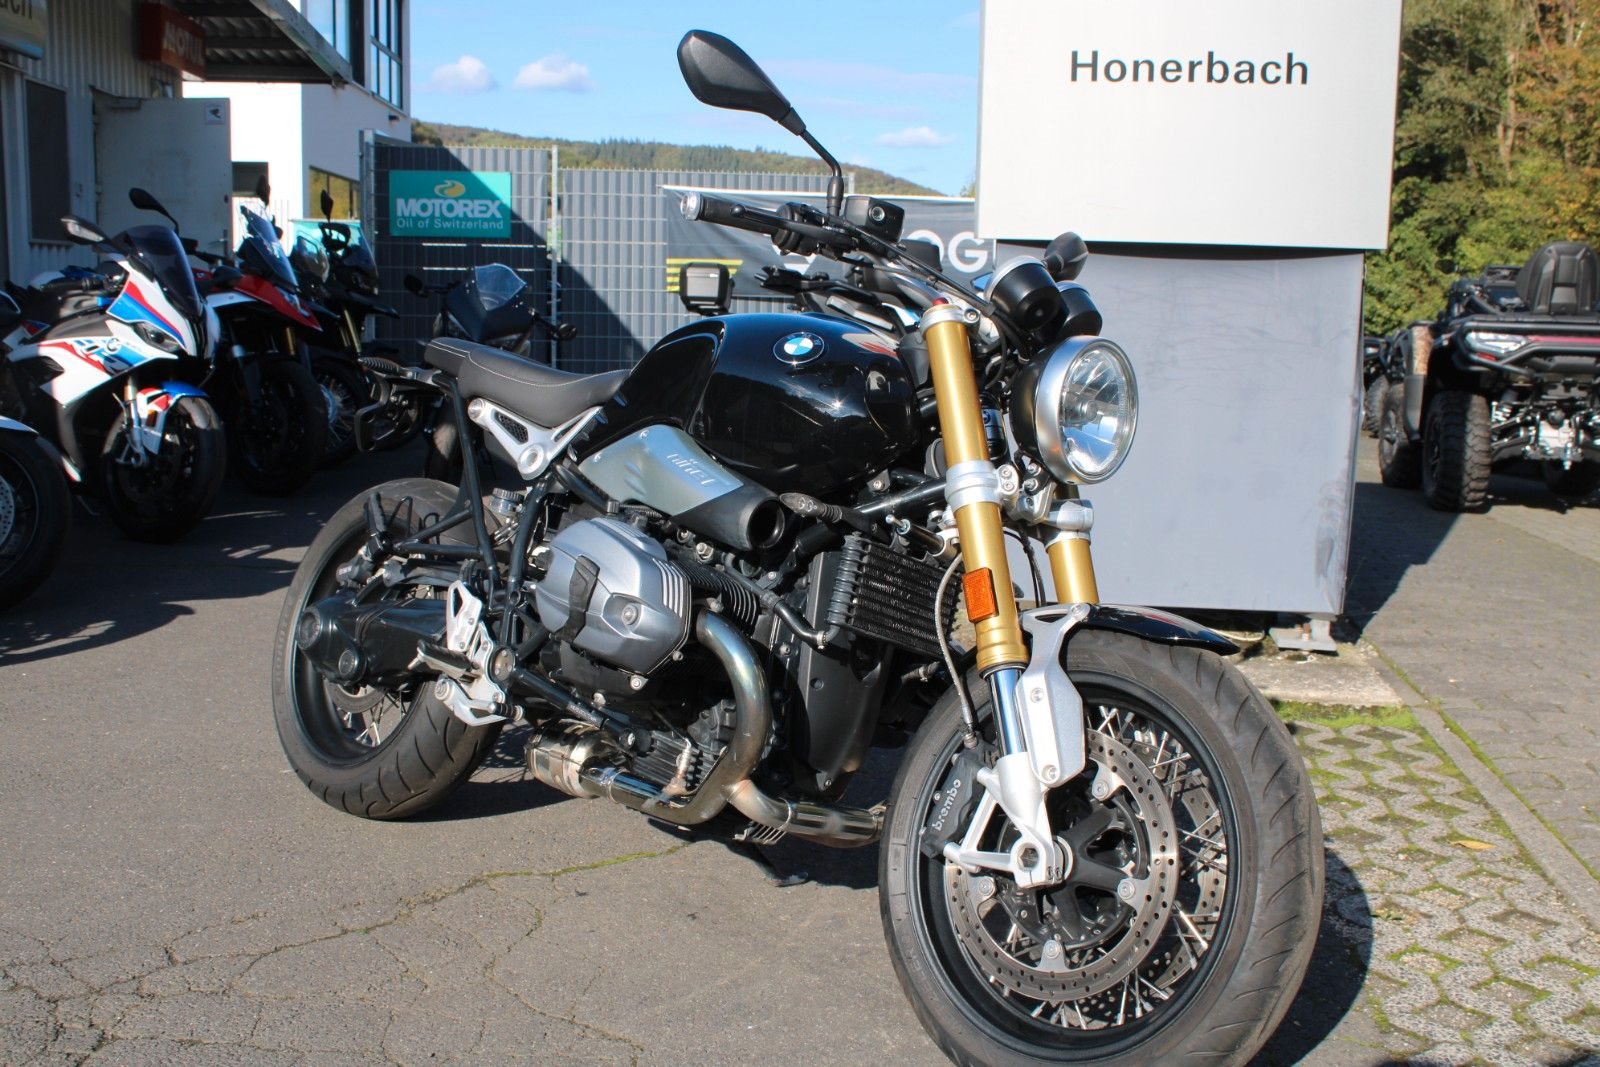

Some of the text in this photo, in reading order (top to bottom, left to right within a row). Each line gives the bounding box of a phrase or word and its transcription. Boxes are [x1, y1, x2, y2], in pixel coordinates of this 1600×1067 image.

[1070, 50, 1308, 85] Honerbach
[396, 198, 502, 218] MOTOREX
[396, 217, 504, 230] Oil of Switzerland
[931, 778, 962, 832] brembo
